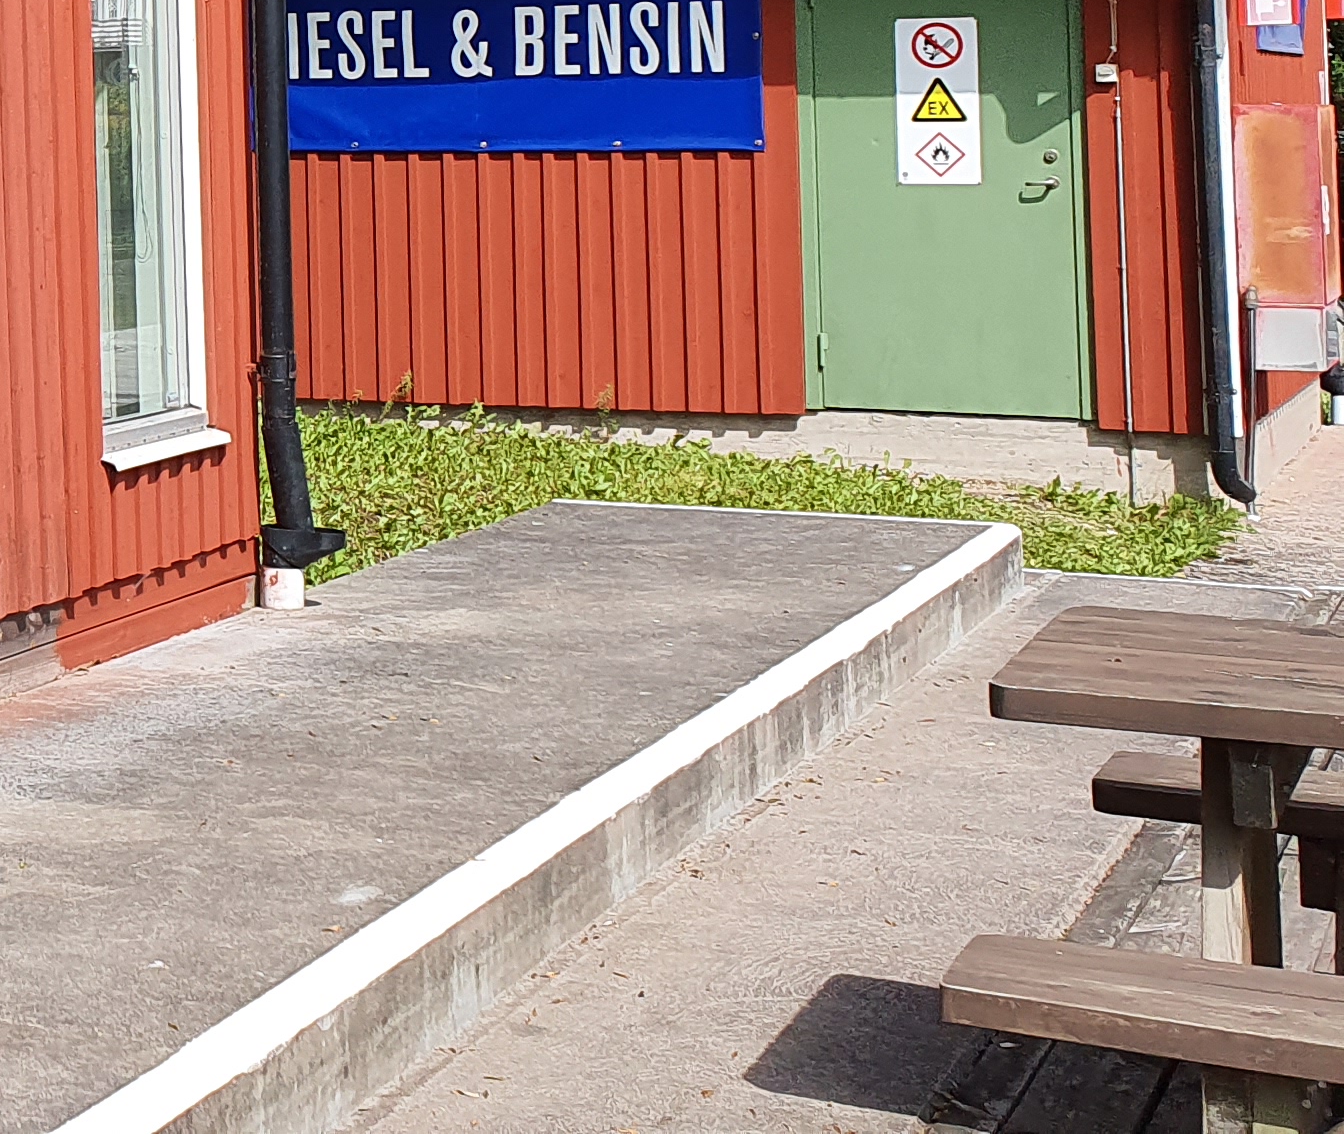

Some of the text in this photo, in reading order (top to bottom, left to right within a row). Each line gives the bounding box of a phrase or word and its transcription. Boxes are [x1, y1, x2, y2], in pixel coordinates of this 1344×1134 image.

[287, 0, 726, 79] IESEL & BENSIN
[928, 101, 949, 115] EX
